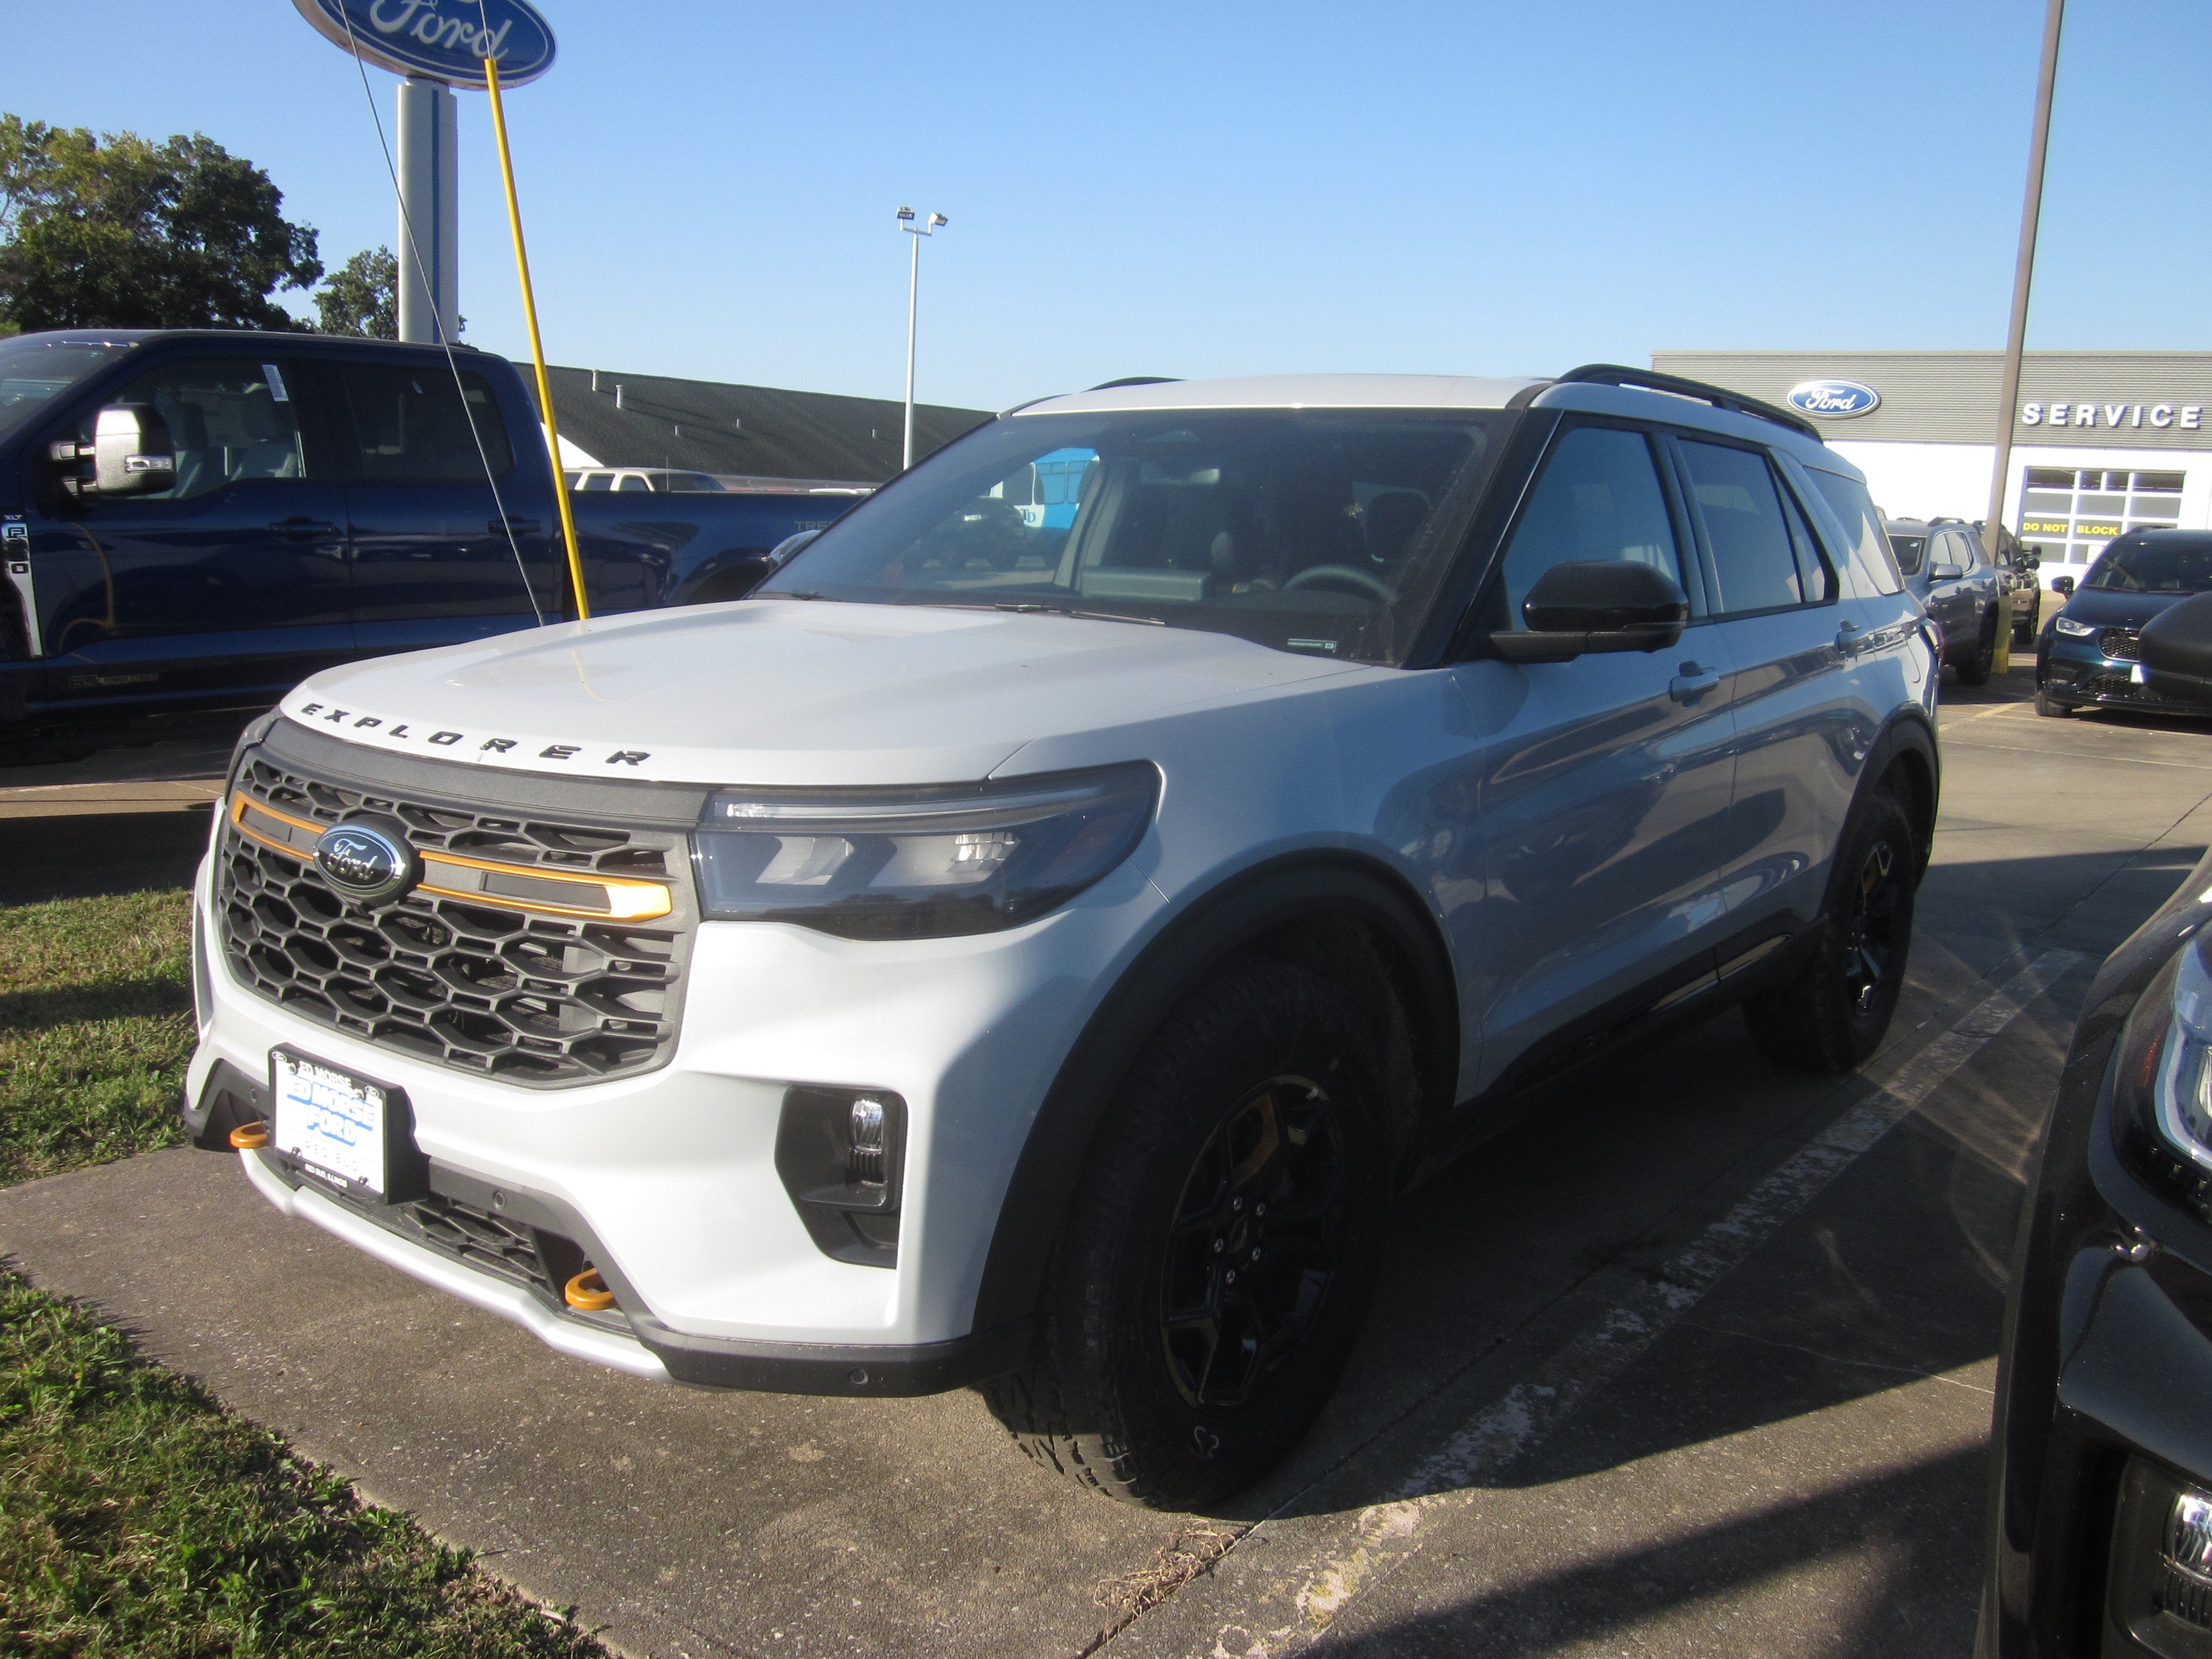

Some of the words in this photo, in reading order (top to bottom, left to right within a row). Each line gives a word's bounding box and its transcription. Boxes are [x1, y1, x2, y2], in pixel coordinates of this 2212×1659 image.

[1805, 388, 1857, 410] Ford
[2021, 403, 2202, 429] SERVICE
[794, 520, 832, 531] TRE
[2022, 523, 2039, 531] DO
[2043, 523, 2068, 533] NOT
[2077, 525, 2119, 535] BLOCK
[301, 703, 651, 766] EXPLORER
[327, 838, 378, 880] Ford
[311, 1081, 375, 1131] MORSE
[306, 1104, 357, 1147] FORD
